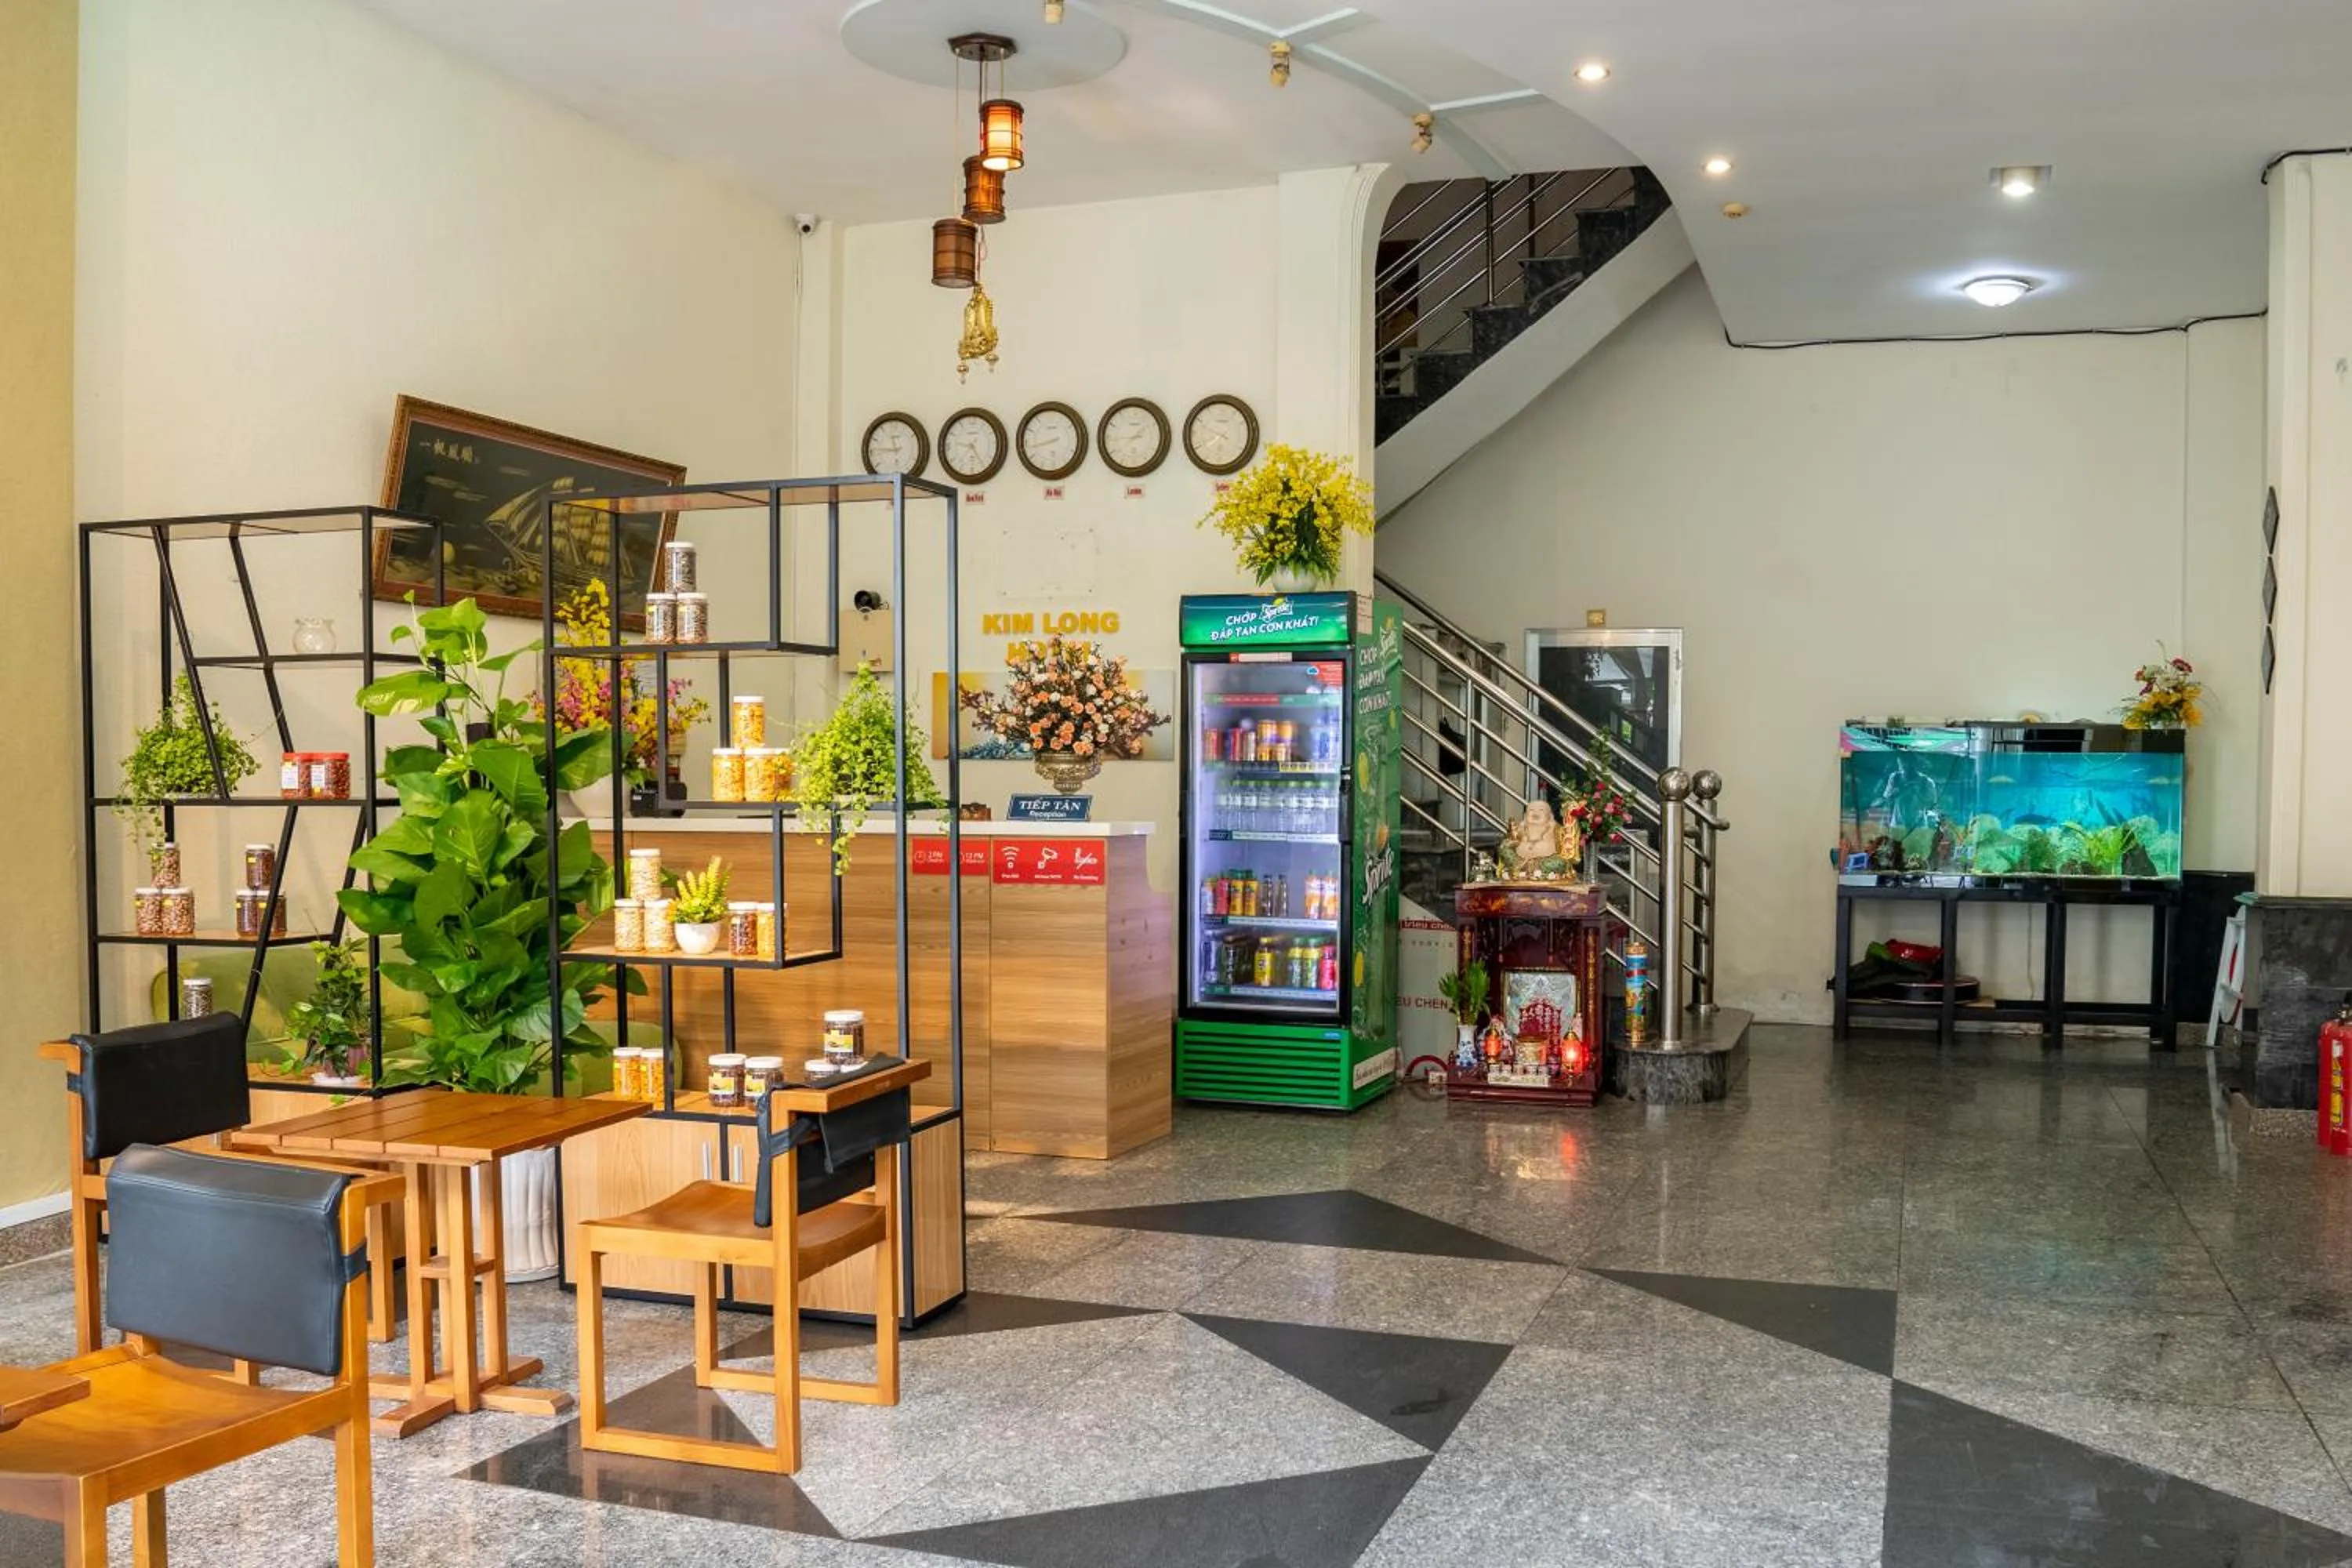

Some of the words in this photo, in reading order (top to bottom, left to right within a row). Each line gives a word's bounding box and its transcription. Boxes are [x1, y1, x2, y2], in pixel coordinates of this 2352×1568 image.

[1261, 599, 1293, 622] Sprite
[982, 613, 1035, 635] KIM
[1042, 610, 1120, 634] LONG
[1235, 626, 1257, 637] TAN
[1019, 797, 1051, 810] TIẾP
[1054, 798, 1081, 811] TÂN
[1362, 844, 1395, 906] Sprite
[1414, 996, 1448, 1010] CHEN
